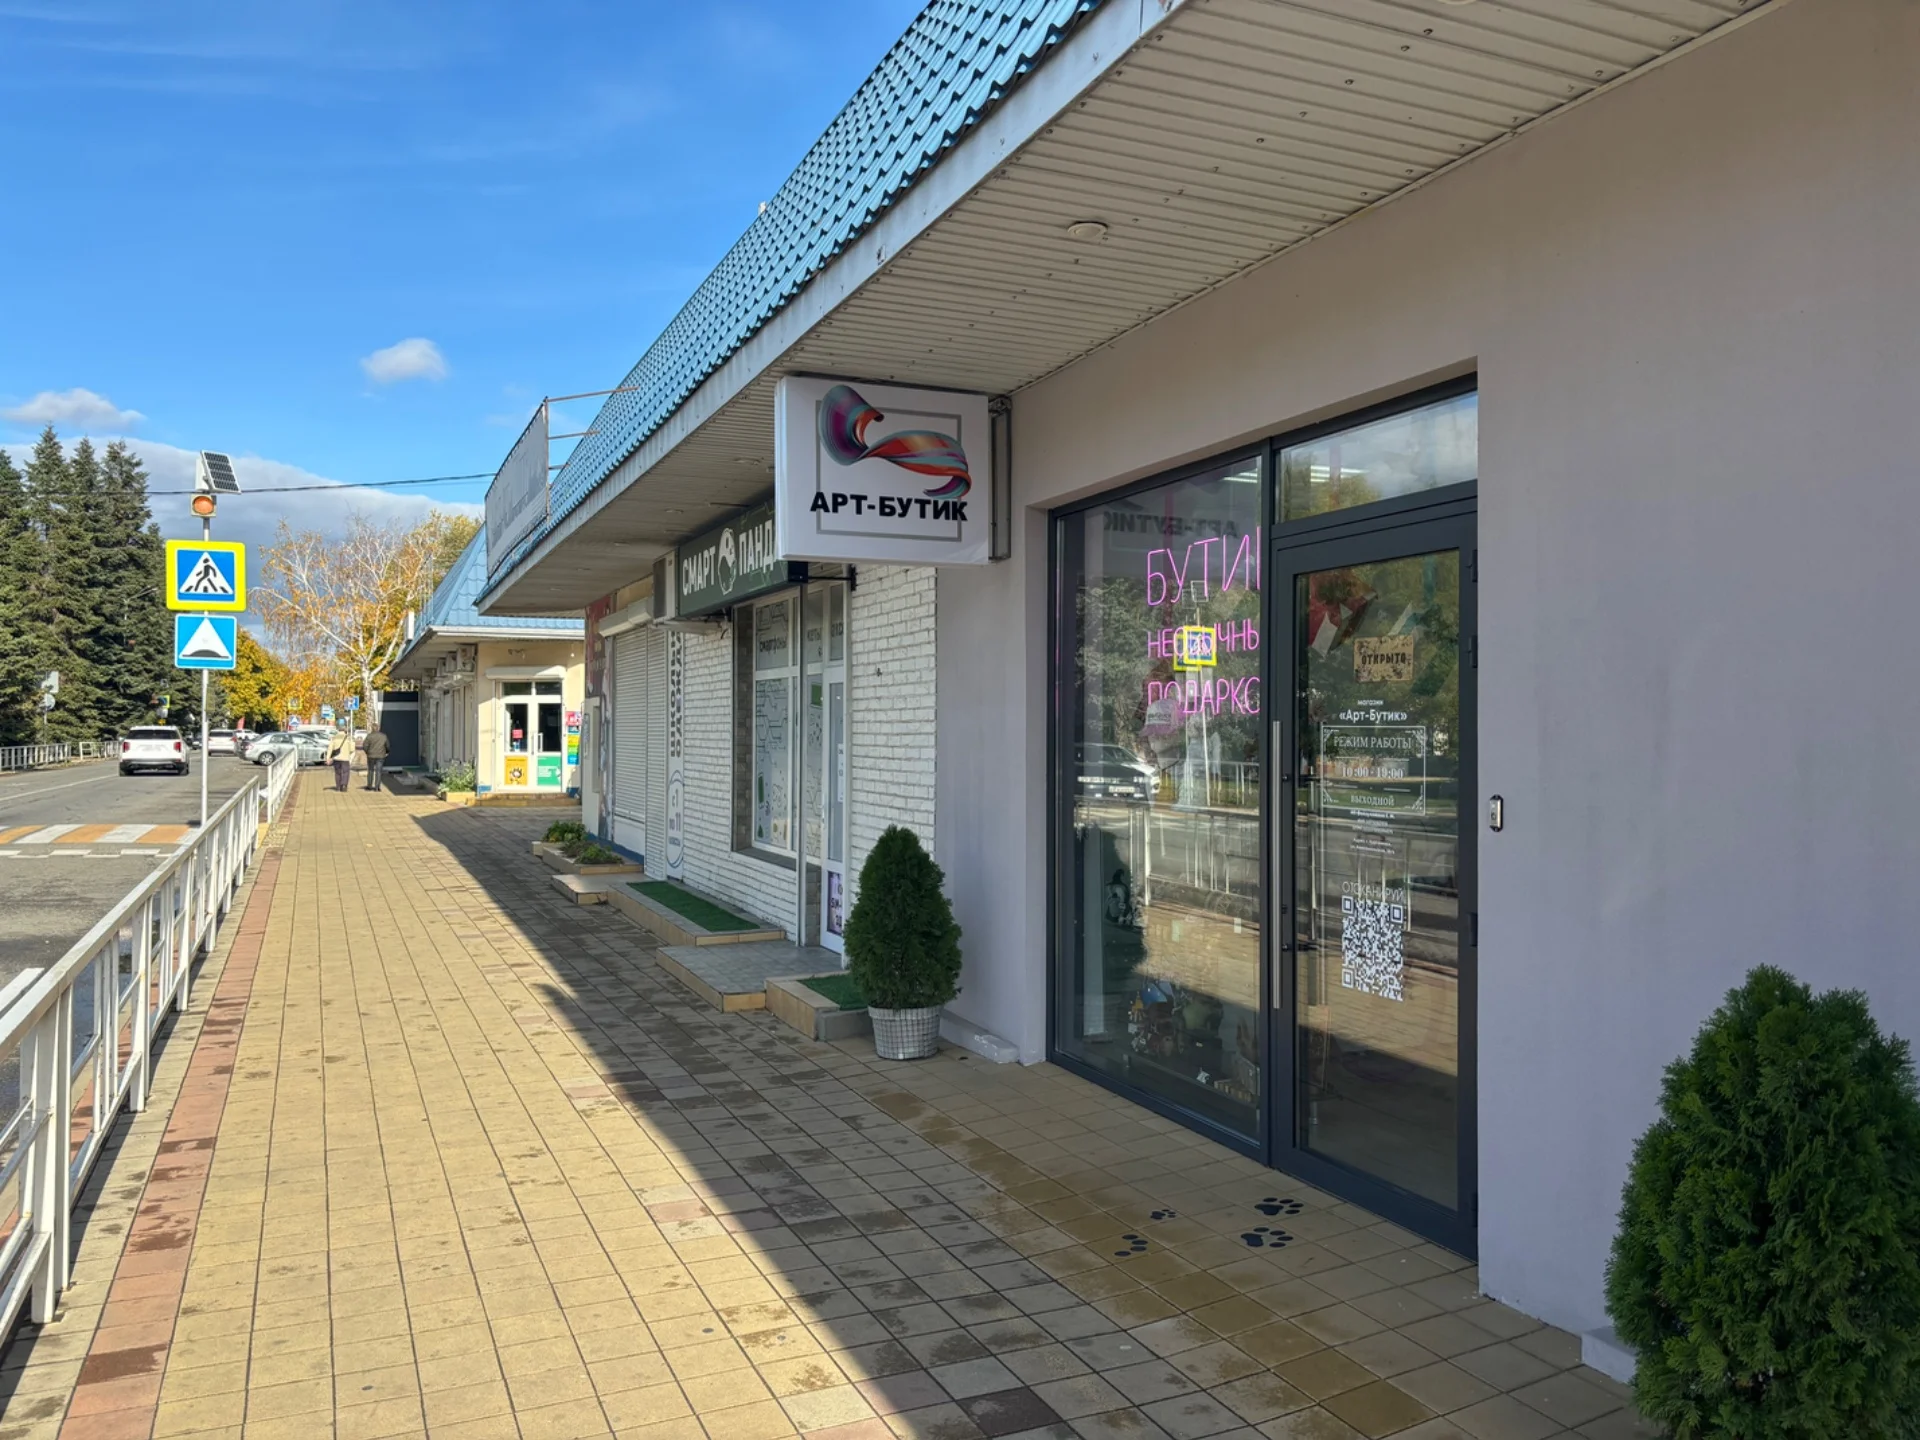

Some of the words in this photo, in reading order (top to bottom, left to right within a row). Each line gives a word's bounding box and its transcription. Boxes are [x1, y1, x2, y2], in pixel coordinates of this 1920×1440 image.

[810, 491, 968, 521] АРТ-БУТИК
[683, 545, 716, 596] СМАРТ
[739, 519, 777, 576] ПАНД
[1361, 652, 1406, 665] ОТКРЫТО
[1339, 708, 1408, 724] «Арт-Бутик»
[1333, 736, 1369, 748] РЕЖИМ
[1370, 736, 1413, 750] РАБОТЫ
[1342, 766, 1370, 778] 10:00
[1377, 766, 1404, 779] 19:00
